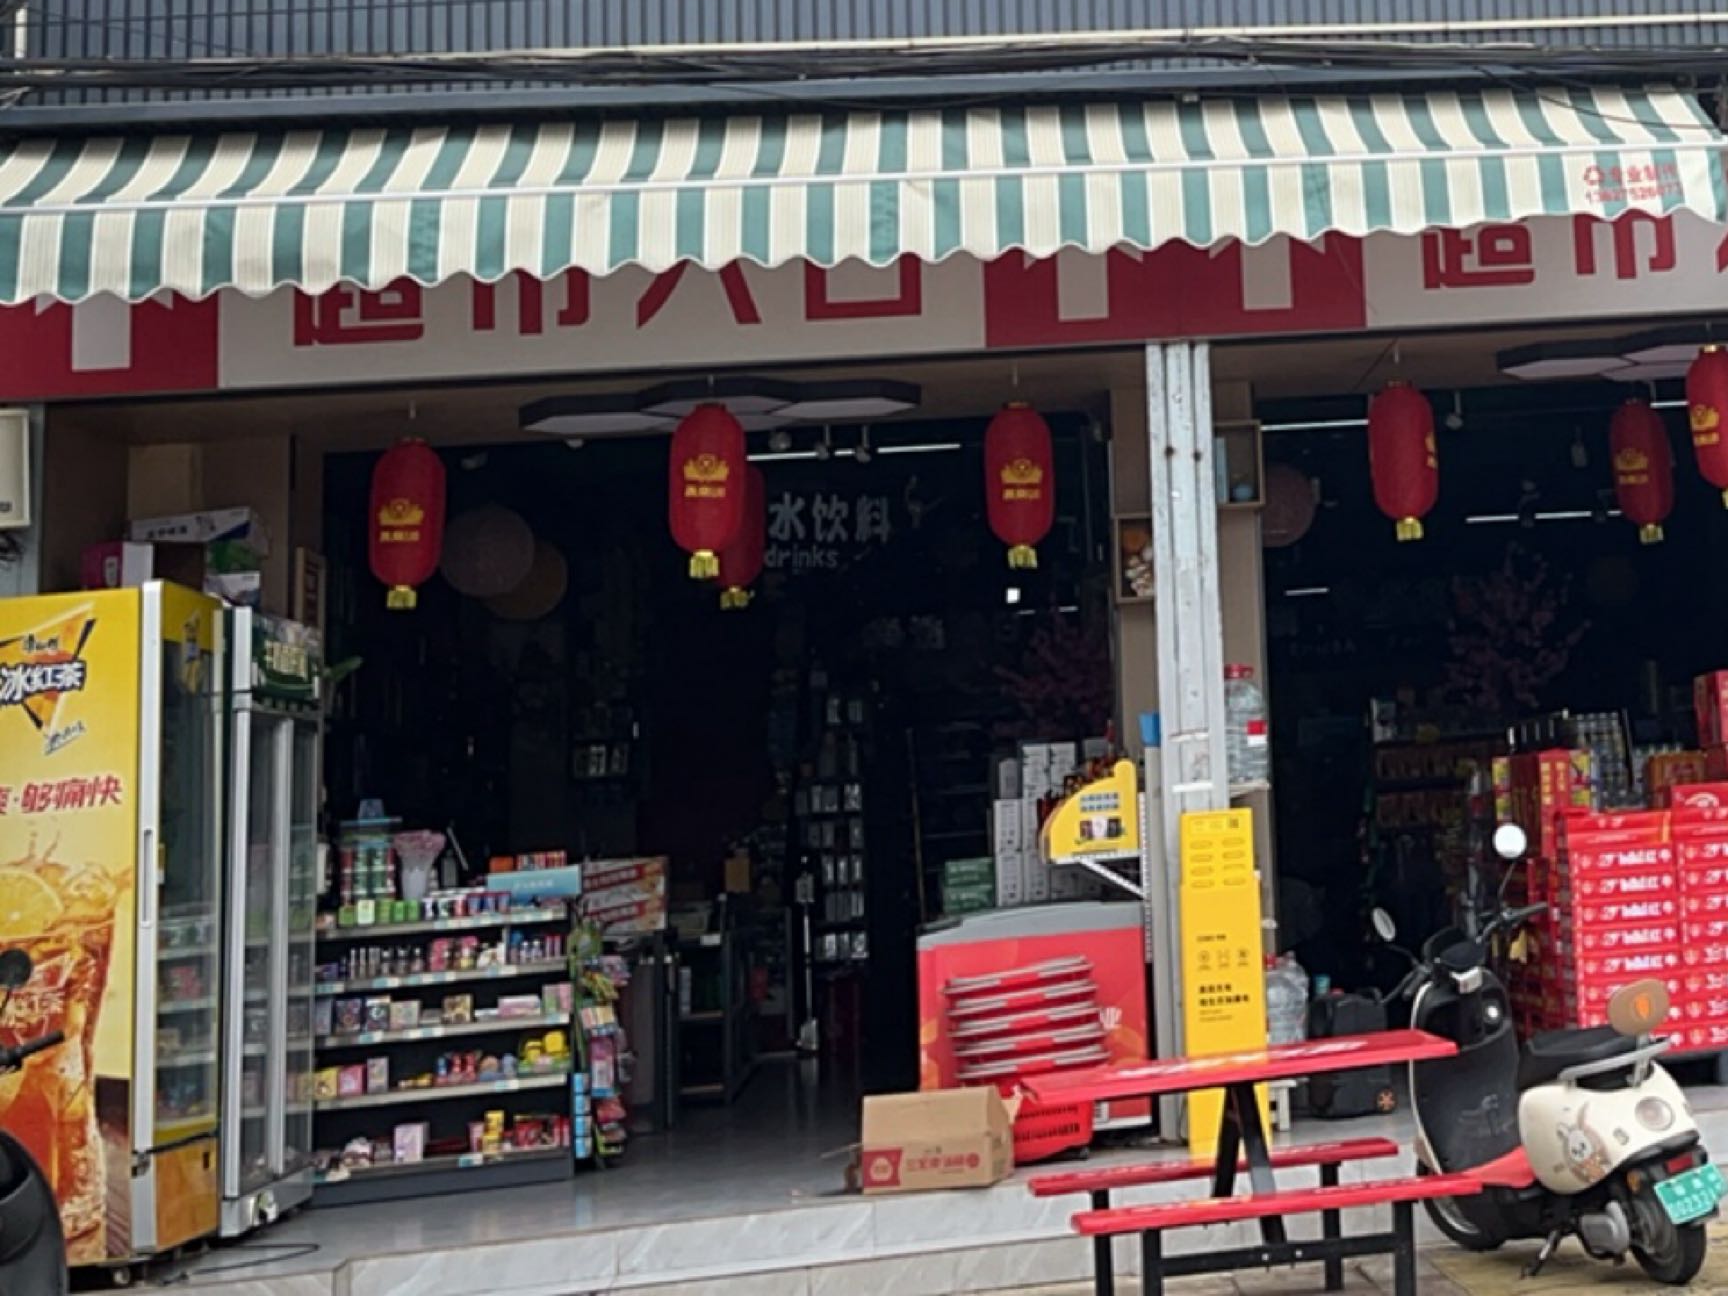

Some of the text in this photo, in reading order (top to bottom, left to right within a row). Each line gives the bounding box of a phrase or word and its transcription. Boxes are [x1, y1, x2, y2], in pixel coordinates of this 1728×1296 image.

[767, 490, 893, 544] 水饮料
[763, 542, 841, 568] drinks
